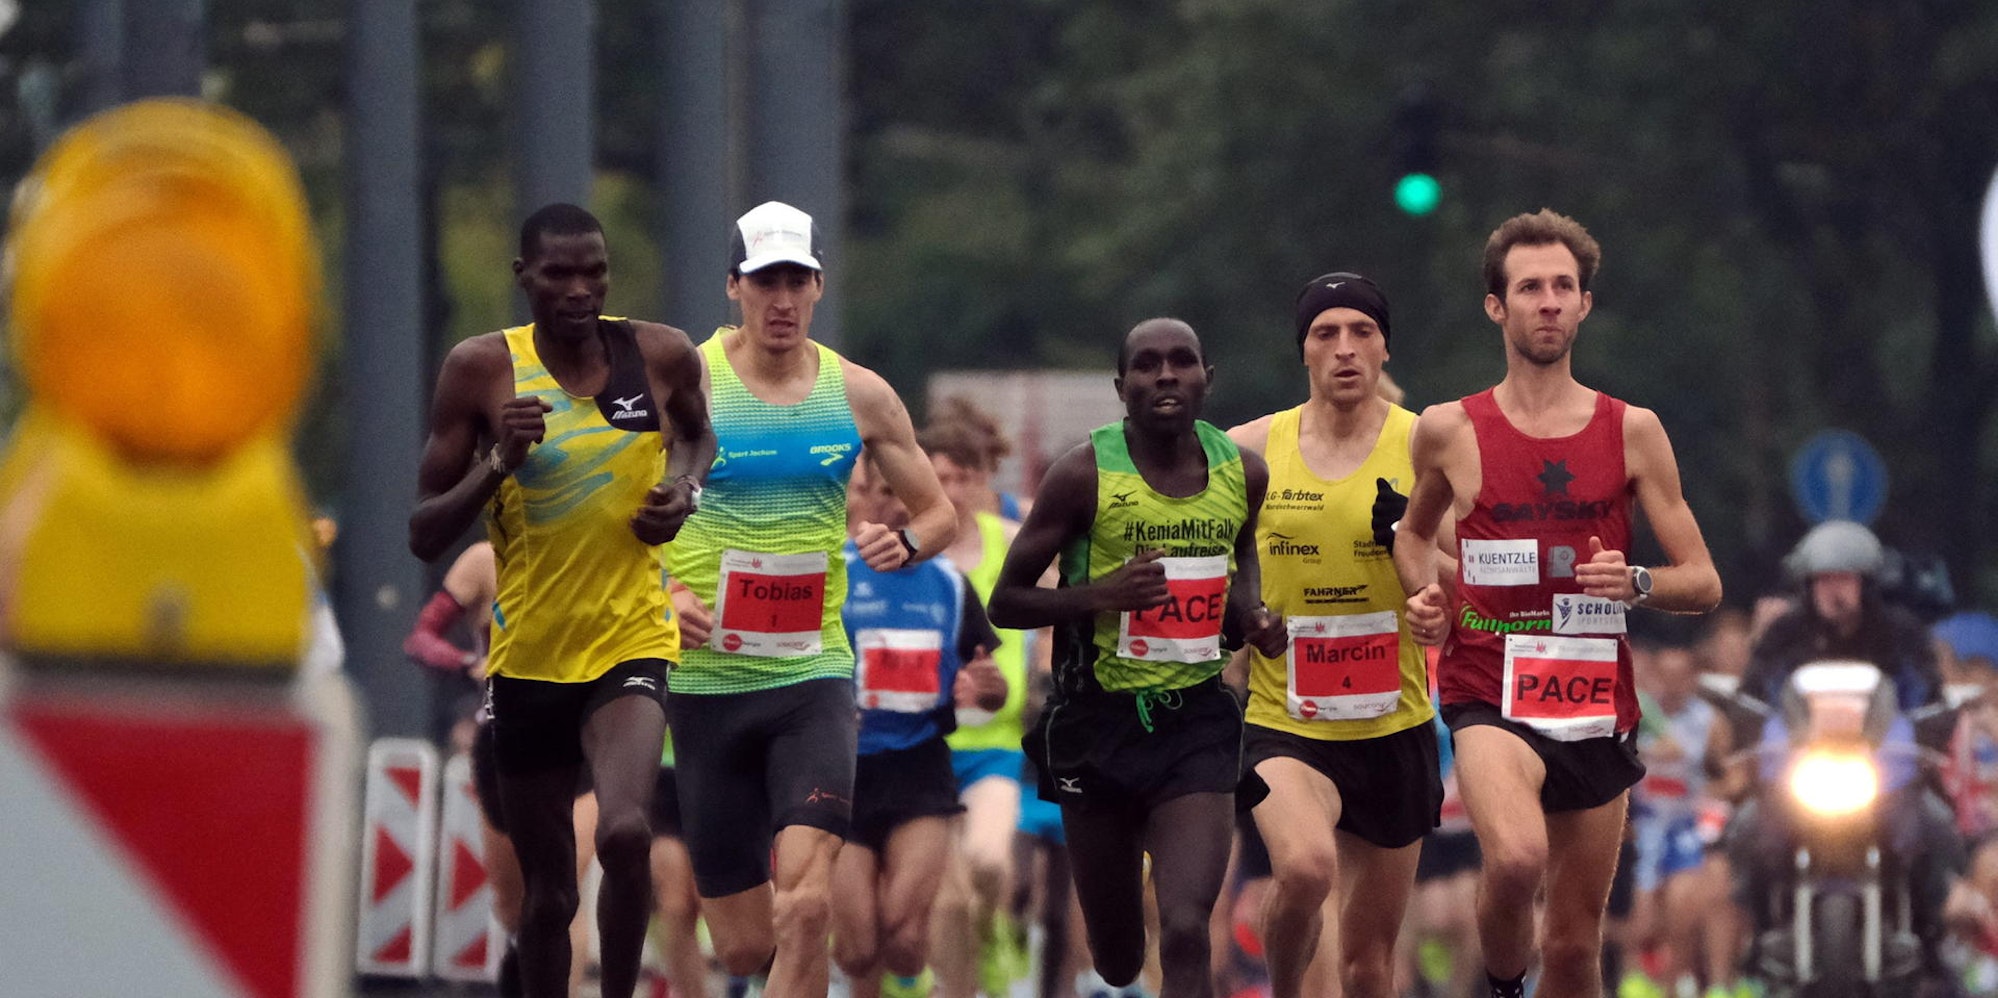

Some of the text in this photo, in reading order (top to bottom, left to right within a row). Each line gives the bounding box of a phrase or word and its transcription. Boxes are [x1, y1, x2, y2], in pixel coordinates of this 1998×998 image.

[809, 442, 852, 454] BROOKS
[1269, 540, 1320, 556] infinex
[1478, 552, 1537, 565] KUENTZLE
[739, 578, 813, 601] Tobias
[770, 614, 778, 628] 1
[1306, 641, 1385, 663] Marcin
[1342, 675, 1352, 689] 4
[1517, 673, 1612, 705] PACE
